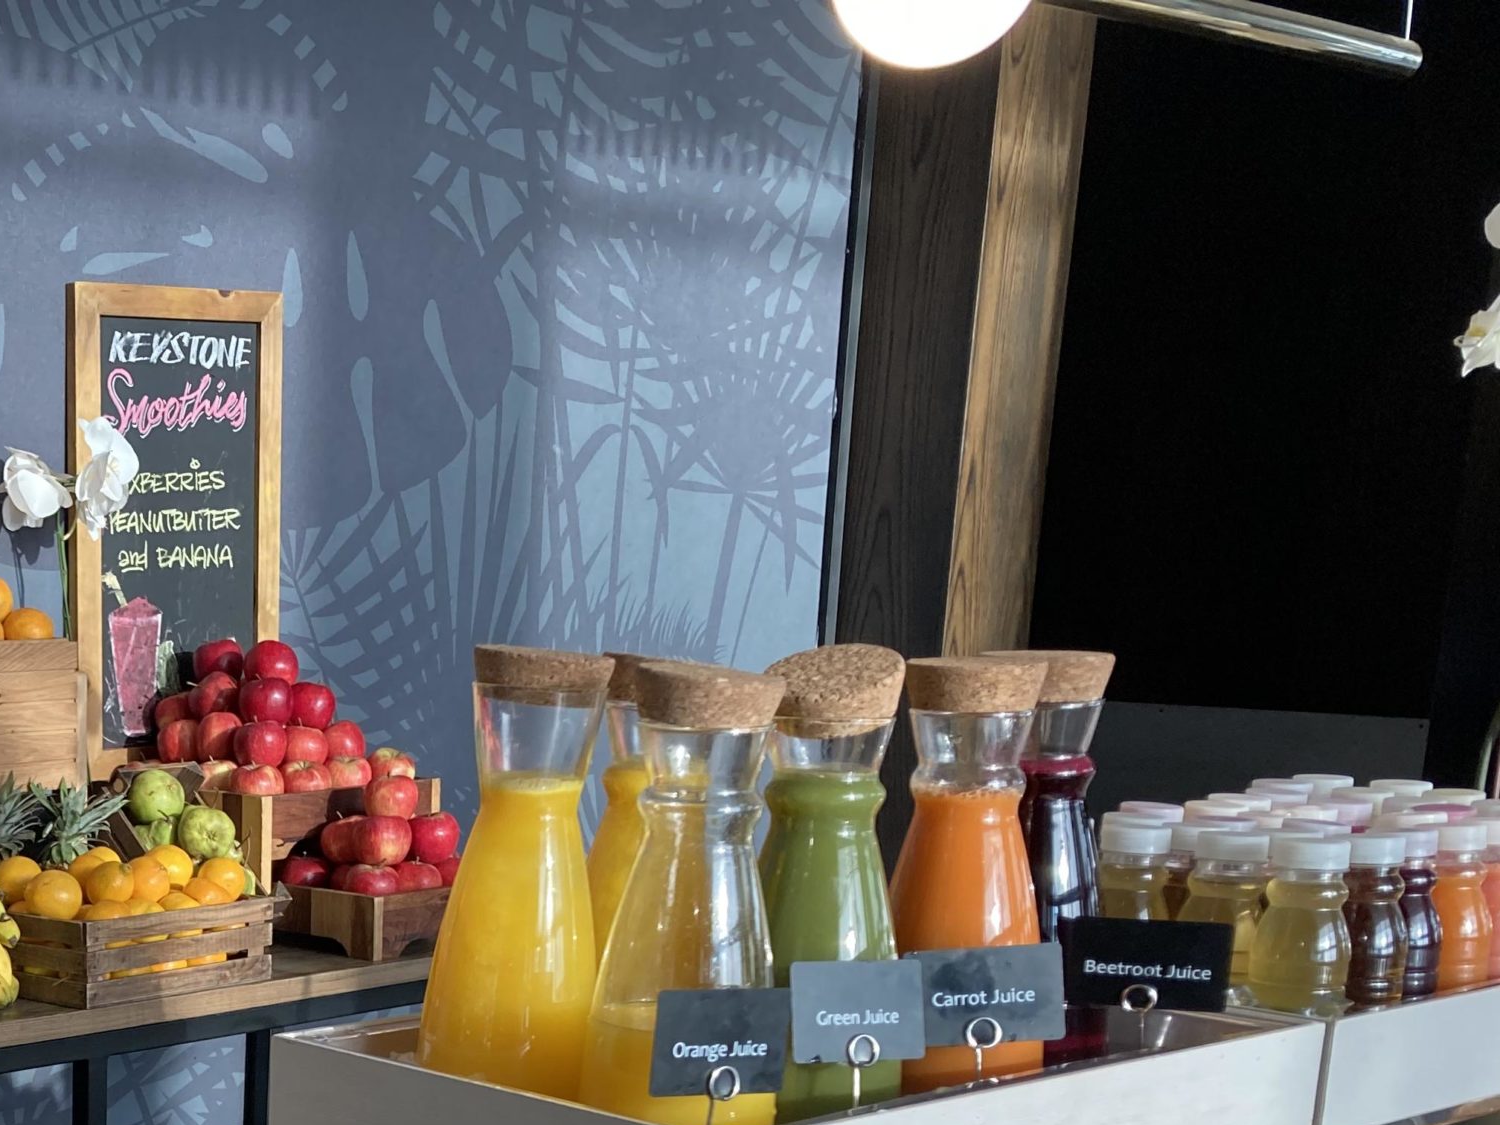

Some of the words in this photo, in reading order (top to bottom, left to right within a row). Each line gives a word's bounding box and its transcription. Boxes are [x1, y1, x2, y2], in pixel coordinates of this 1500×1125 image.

[108, 330, 252, 369] KEYSTONE
[103, 368, 247, 438] Smoothies
[128, 458, 226, 494] XBERRIES
[108, 507, 241, 535] PEANUTBUTTER
[118, 540, 148, 572] and
[156, 543, 234, 569] BANANA
[1084, 959, 1163, 977] Beetroot
[1164, 964, 1212, 980] Juice
[931, 991, 988, 1007] Carrot
[991, 988, 1036, 1004] Juice
[816, 1010, 860, 1026] Green
[862, 1009, 899, 1024] Juice
[672, 1041, 728, 1062] Orange
[729, 1040, 768, 1057] Juice
